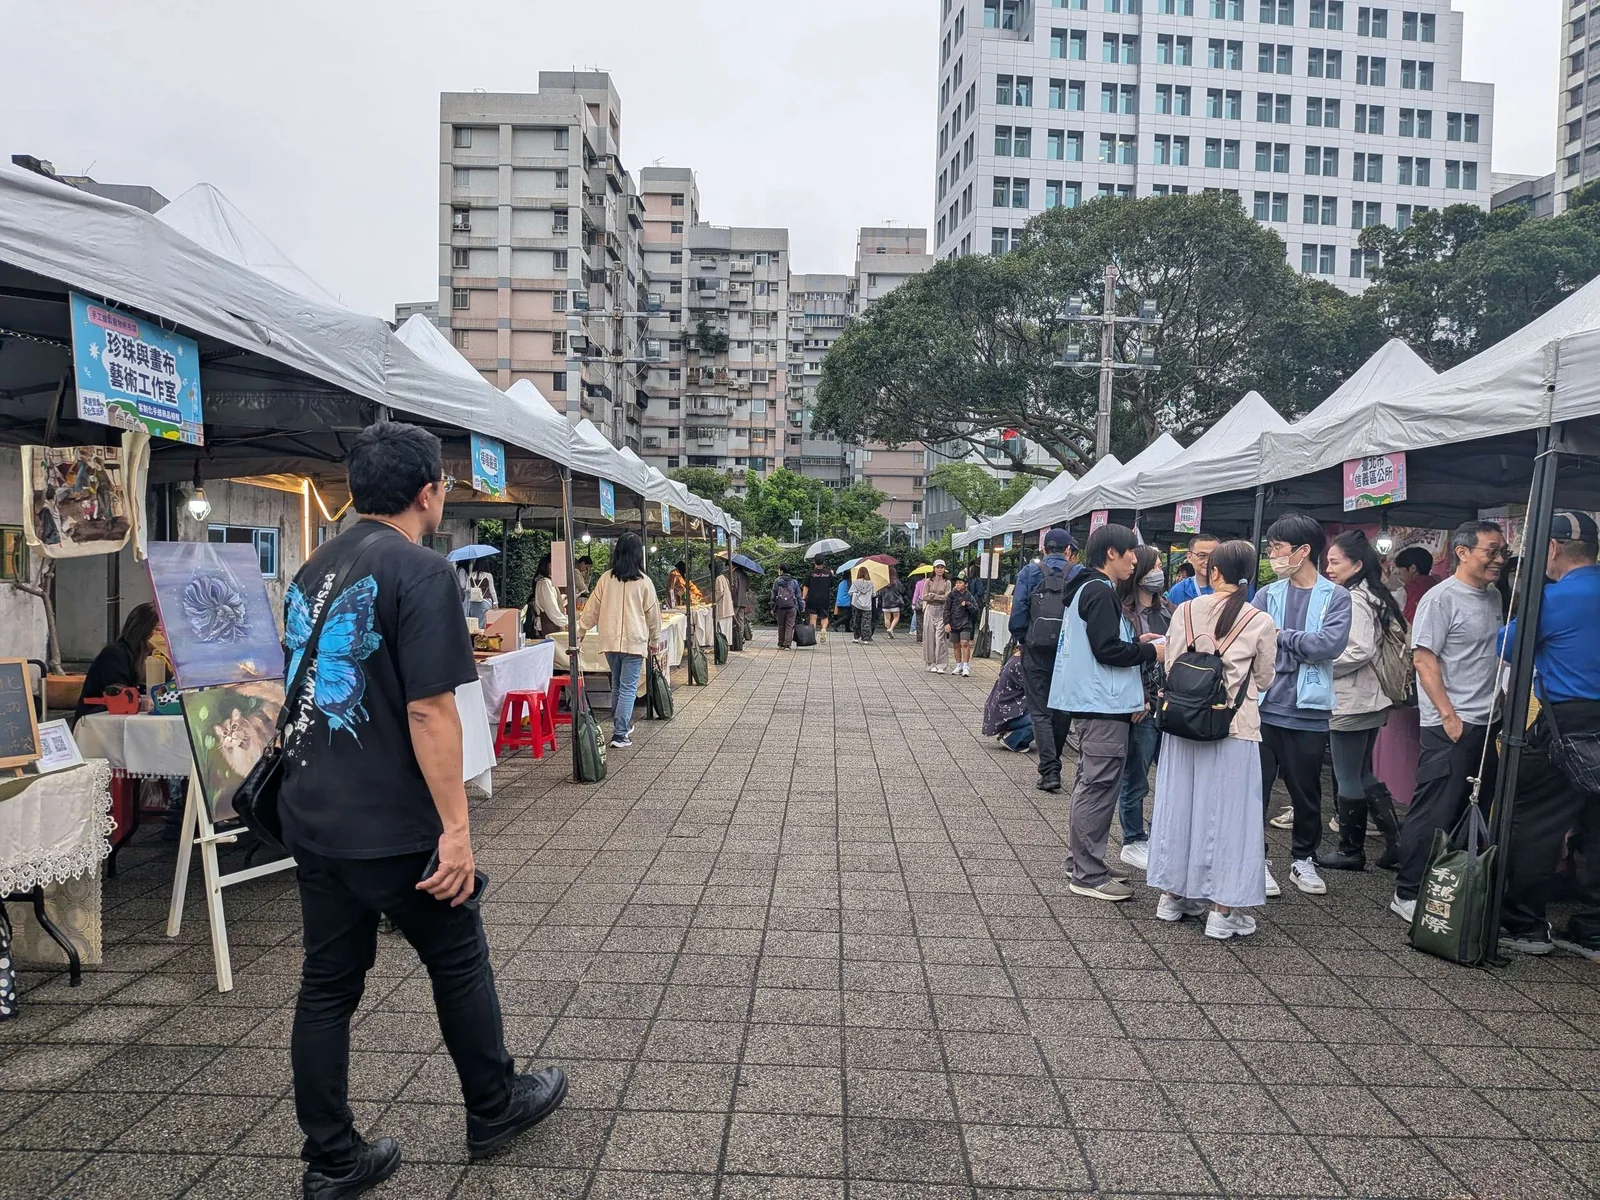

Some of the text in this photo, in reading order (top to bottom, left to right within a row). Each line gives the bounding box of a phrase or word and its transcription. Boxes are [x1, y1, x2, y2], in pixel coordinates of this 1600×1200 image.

[107, 331, 175, 377] 珍珠與畫布
[109, 361, 177, 404] 藝術工作室
[1355, 465, 1393, 488] 信義區公所
[1361, 456, 1384, 472] 臺北市
